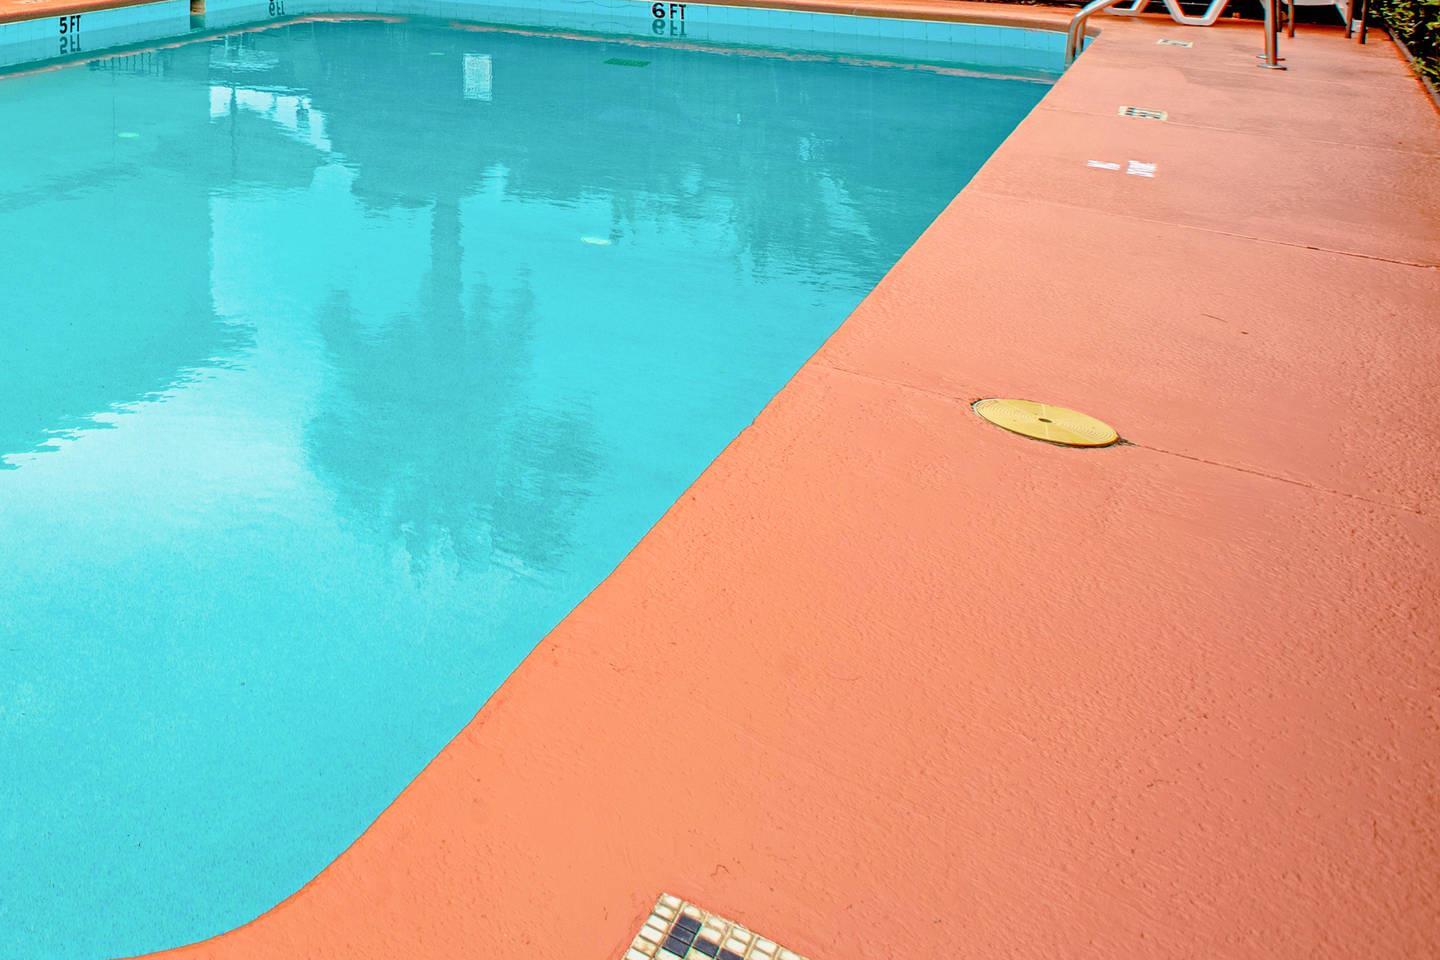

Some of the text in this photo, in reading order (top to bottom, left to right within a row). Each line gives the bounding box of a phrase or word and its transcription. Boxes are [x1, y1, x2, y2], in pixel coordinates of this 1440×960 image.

[652, 2, 686, 19] 6 FT
[59, 14, 81, 34] 5 FT
